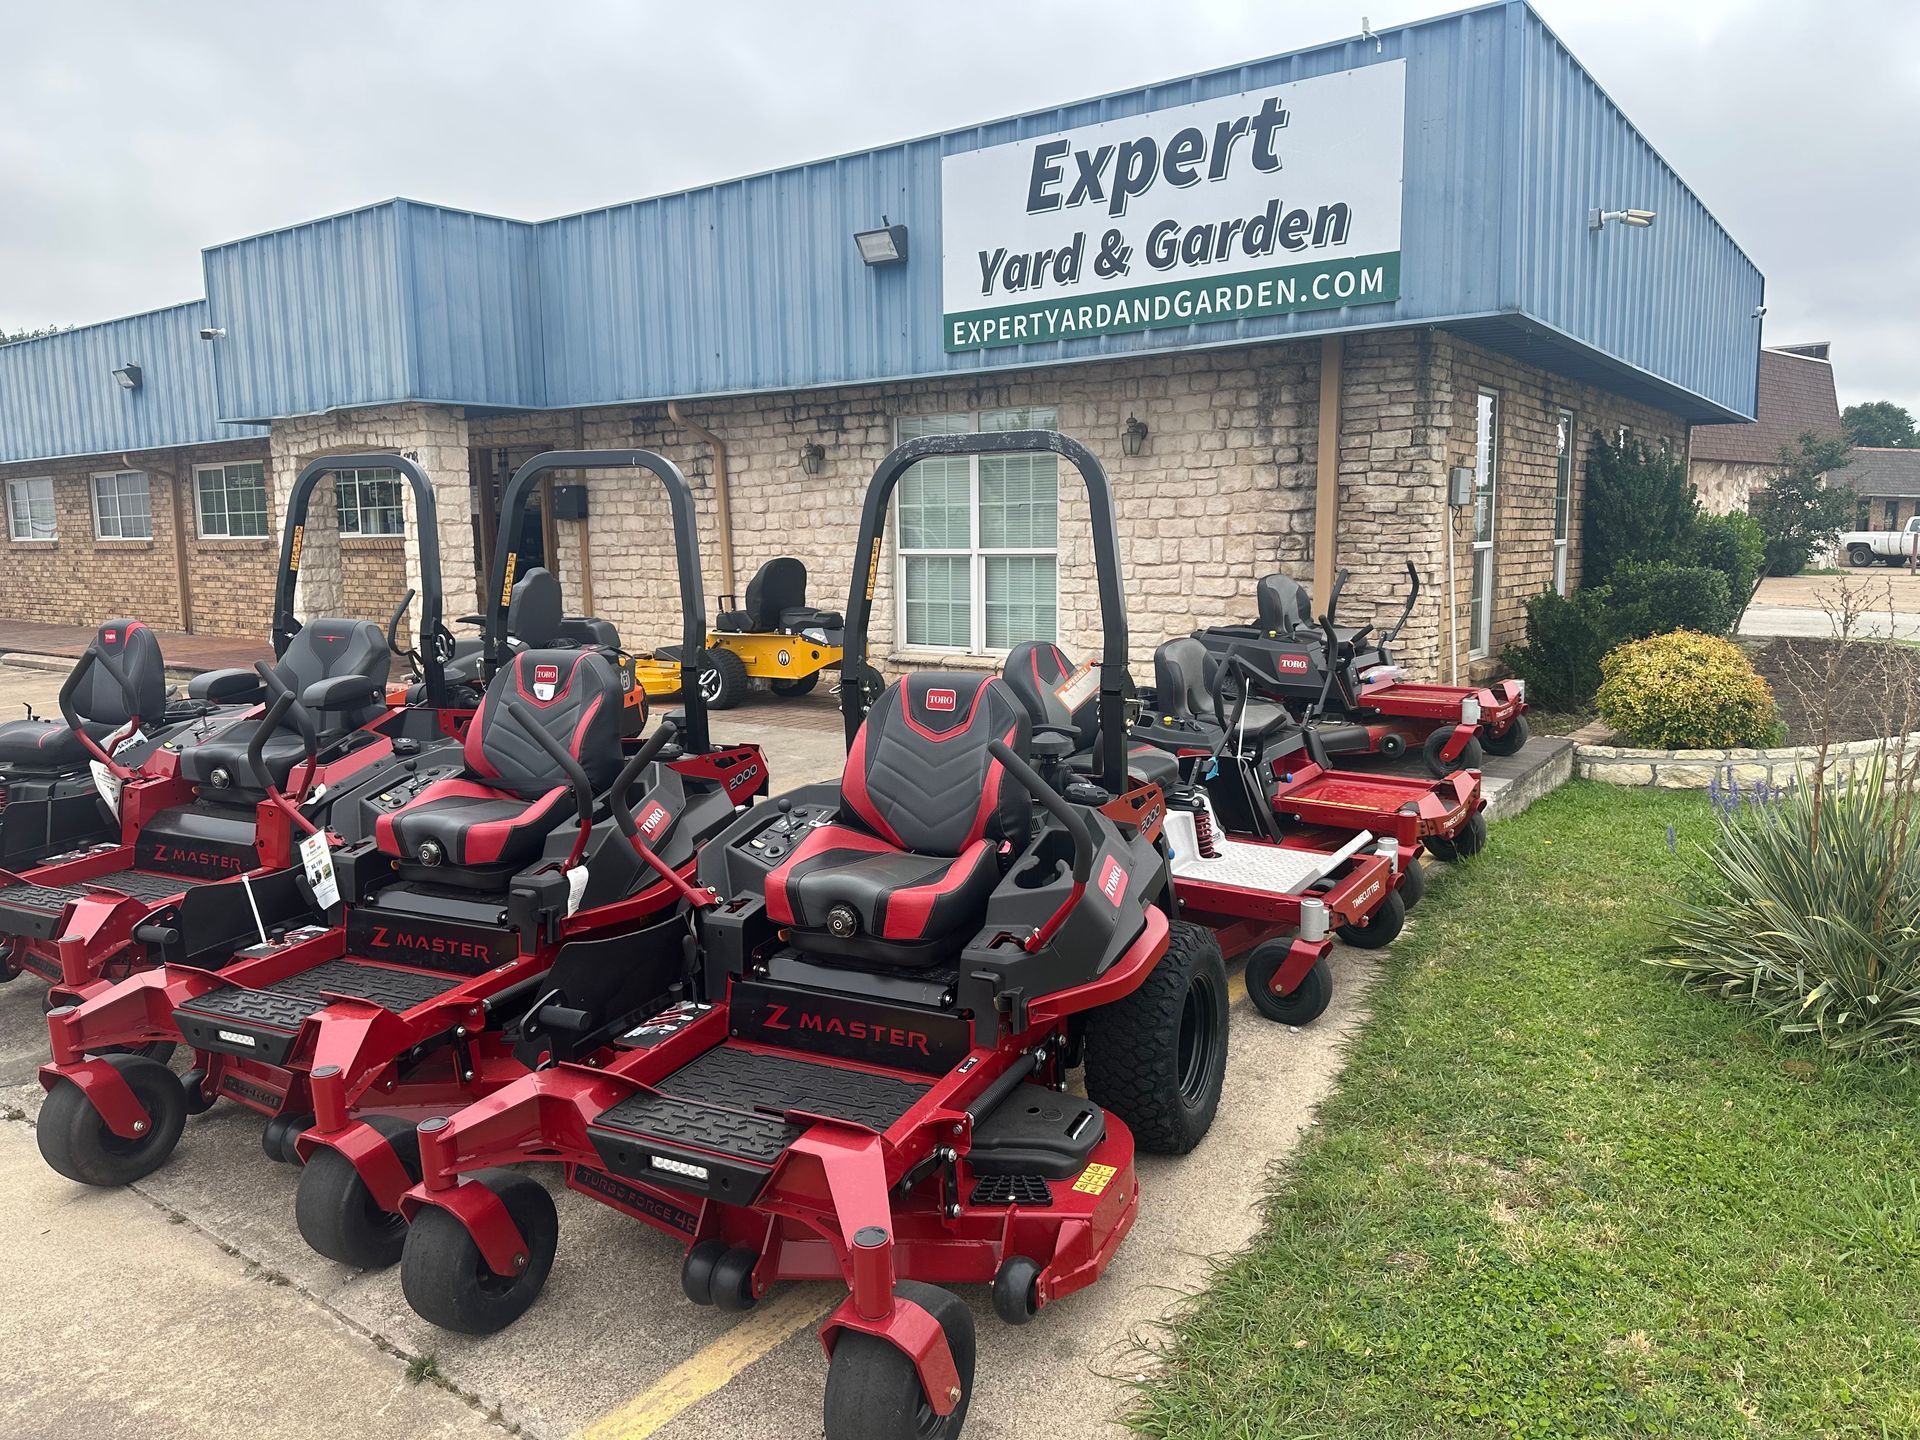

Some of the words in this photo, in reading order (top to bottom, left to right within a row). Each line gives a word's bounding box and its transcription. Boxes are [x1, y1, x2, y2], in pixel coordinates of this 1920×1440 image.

[1026, 97, 1290, 218] Expert
[978, 232, 1086, 296] Yard
[1094, 229, 1133, 279] &
[1146, 199, 1351, 271] Garden
[953, 267, 1383, 345] EXPERTYARDANDGARDEN.COM
[929, 695, 953, 704] TORO
[729, 764, 758, 790] 2000
[640, 807, 665, 834] TORO
[154, 844, 168, 861] Z
[173, 849, 242, 873] MASTER
[1104, 865, 1121, 898] TORO
[1352, 880, 1380, 909] TIMECUTTER
[370, 926, 391, 948] Z
[396, 932, 490, 964] MASTER
[762, 1003, 791, 1030] Z
[800, 1012, 930, 1056] MASTER
[583, 1171, 626, 1197] TURBO
[628, 1191, 672, 1220] FORCE
